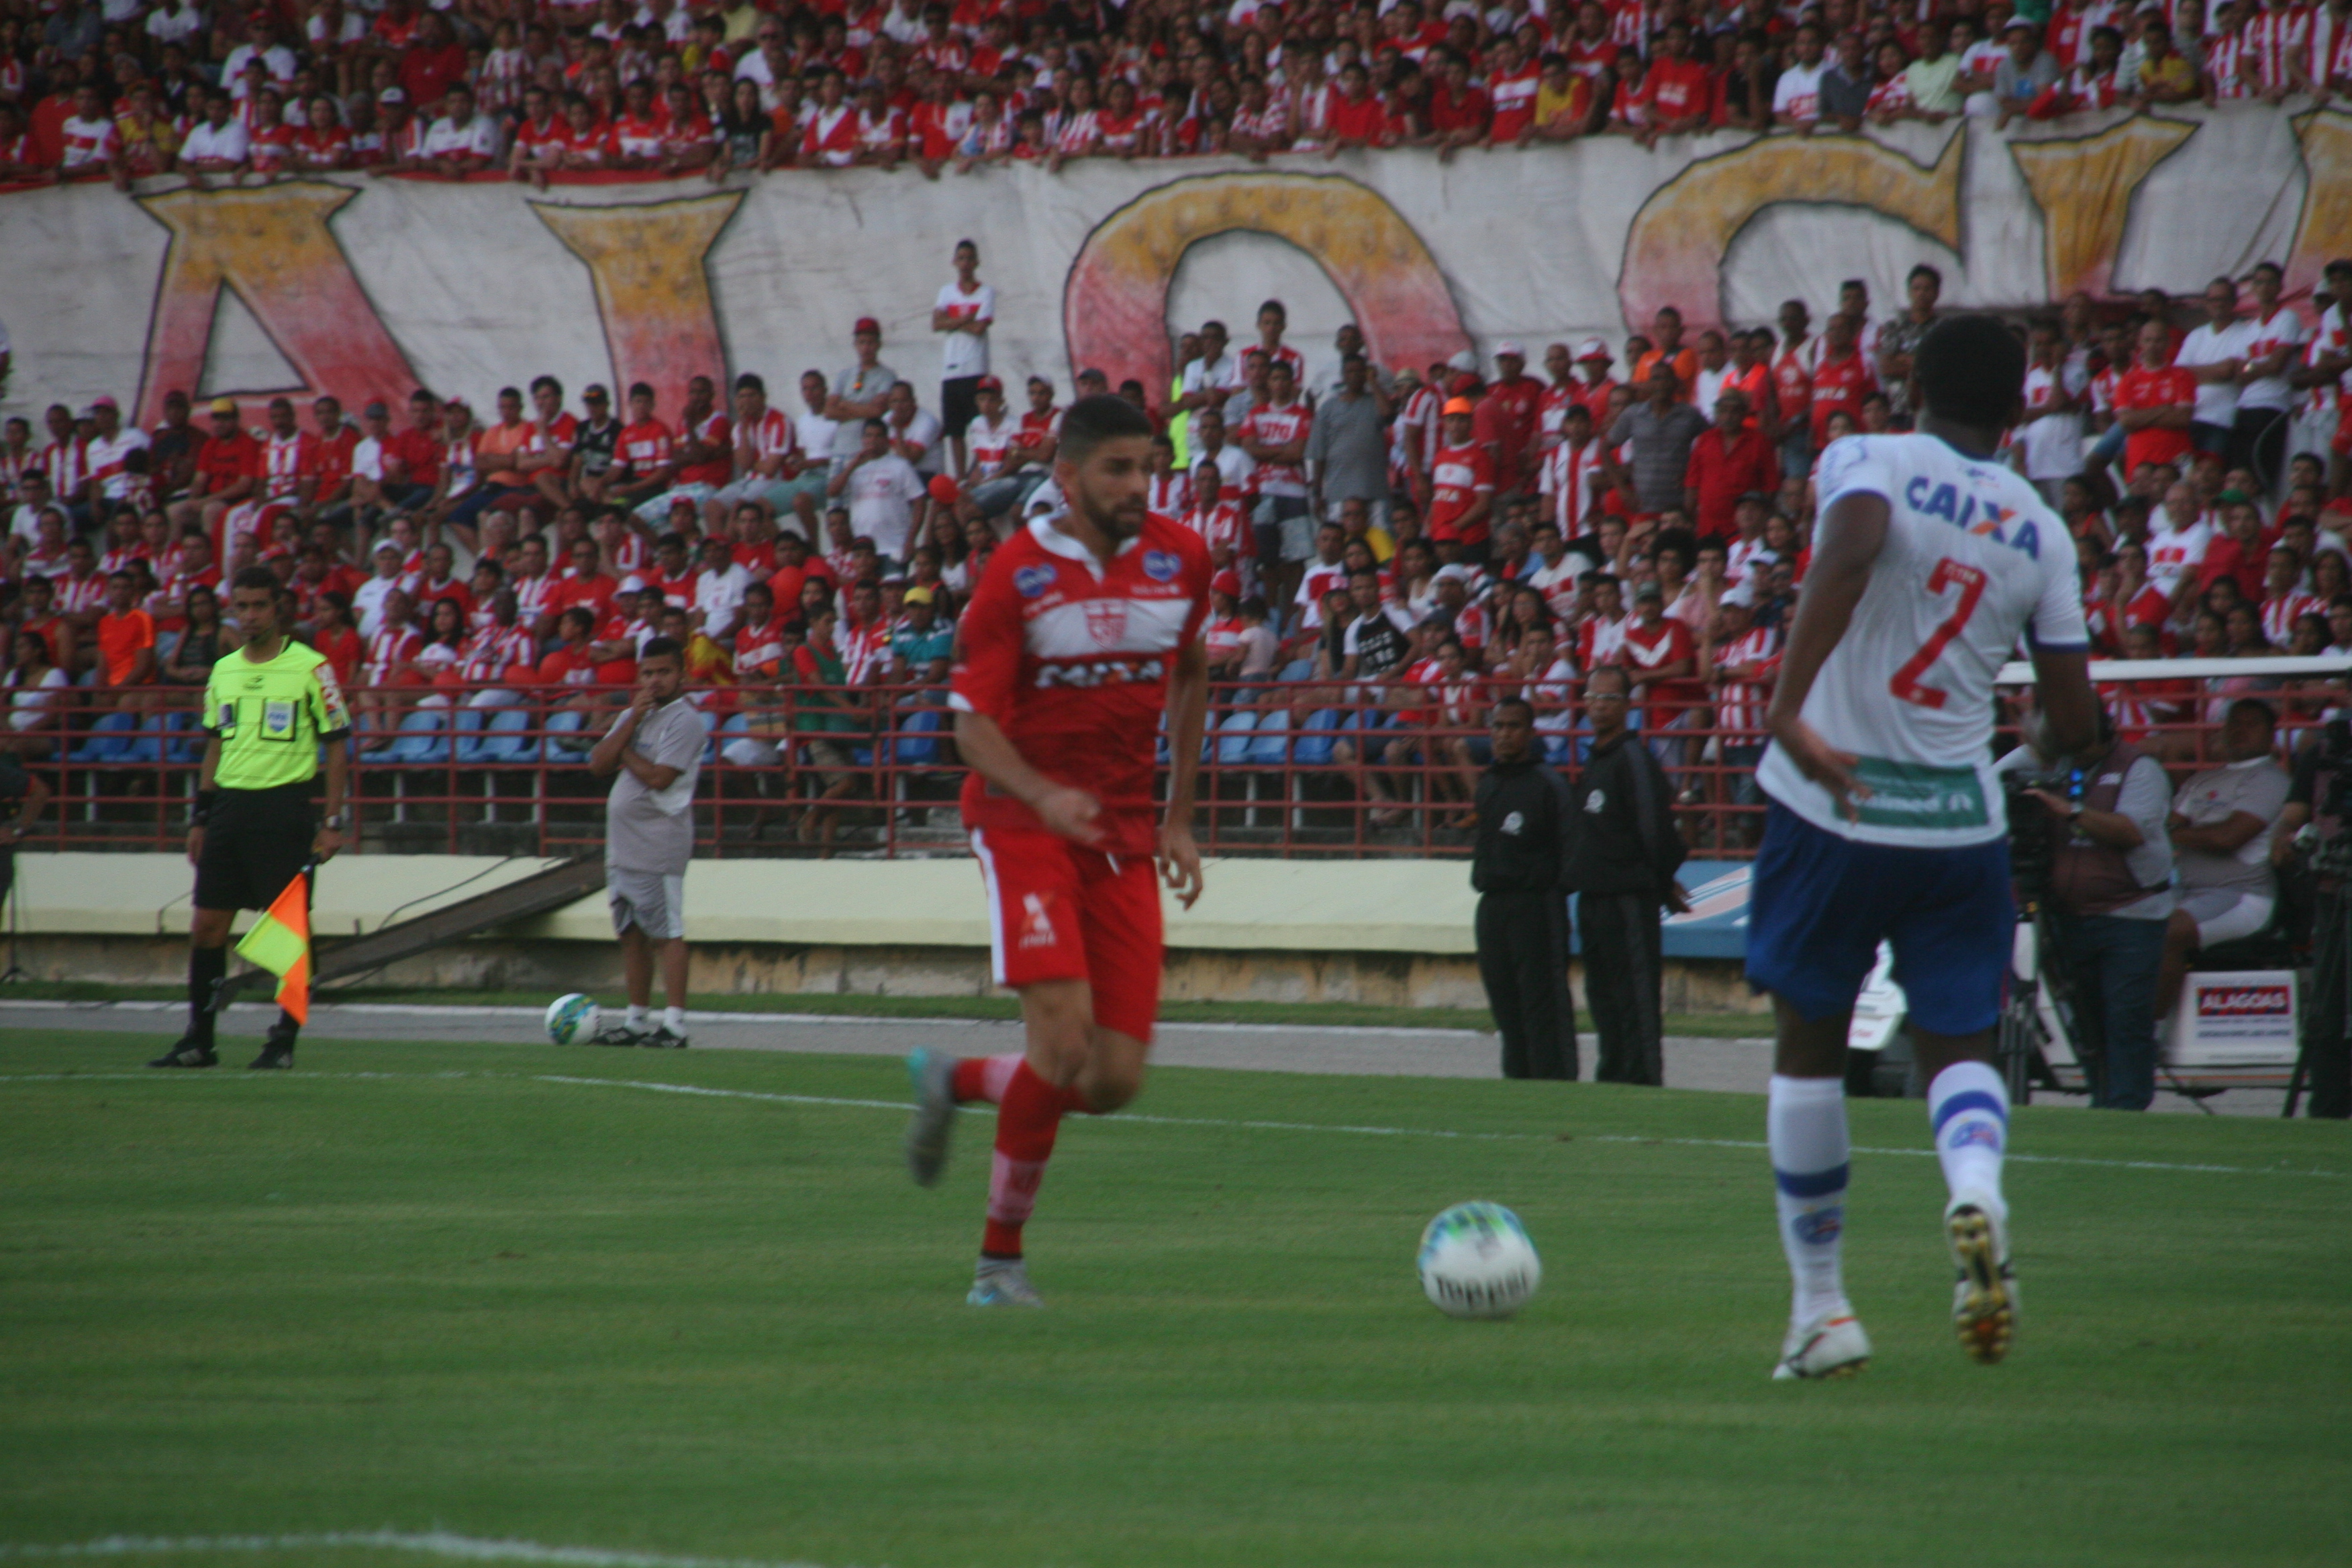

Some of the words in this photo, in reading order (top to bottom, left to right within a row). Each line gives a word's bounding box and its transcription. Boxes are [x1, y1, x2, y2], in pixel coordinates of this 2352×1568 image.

[1906, 476, 2039, 560] CAIXA
[1890, 556, 1987, 708] 2
[2201, 992, 2286, 1008] ALAGOAS
